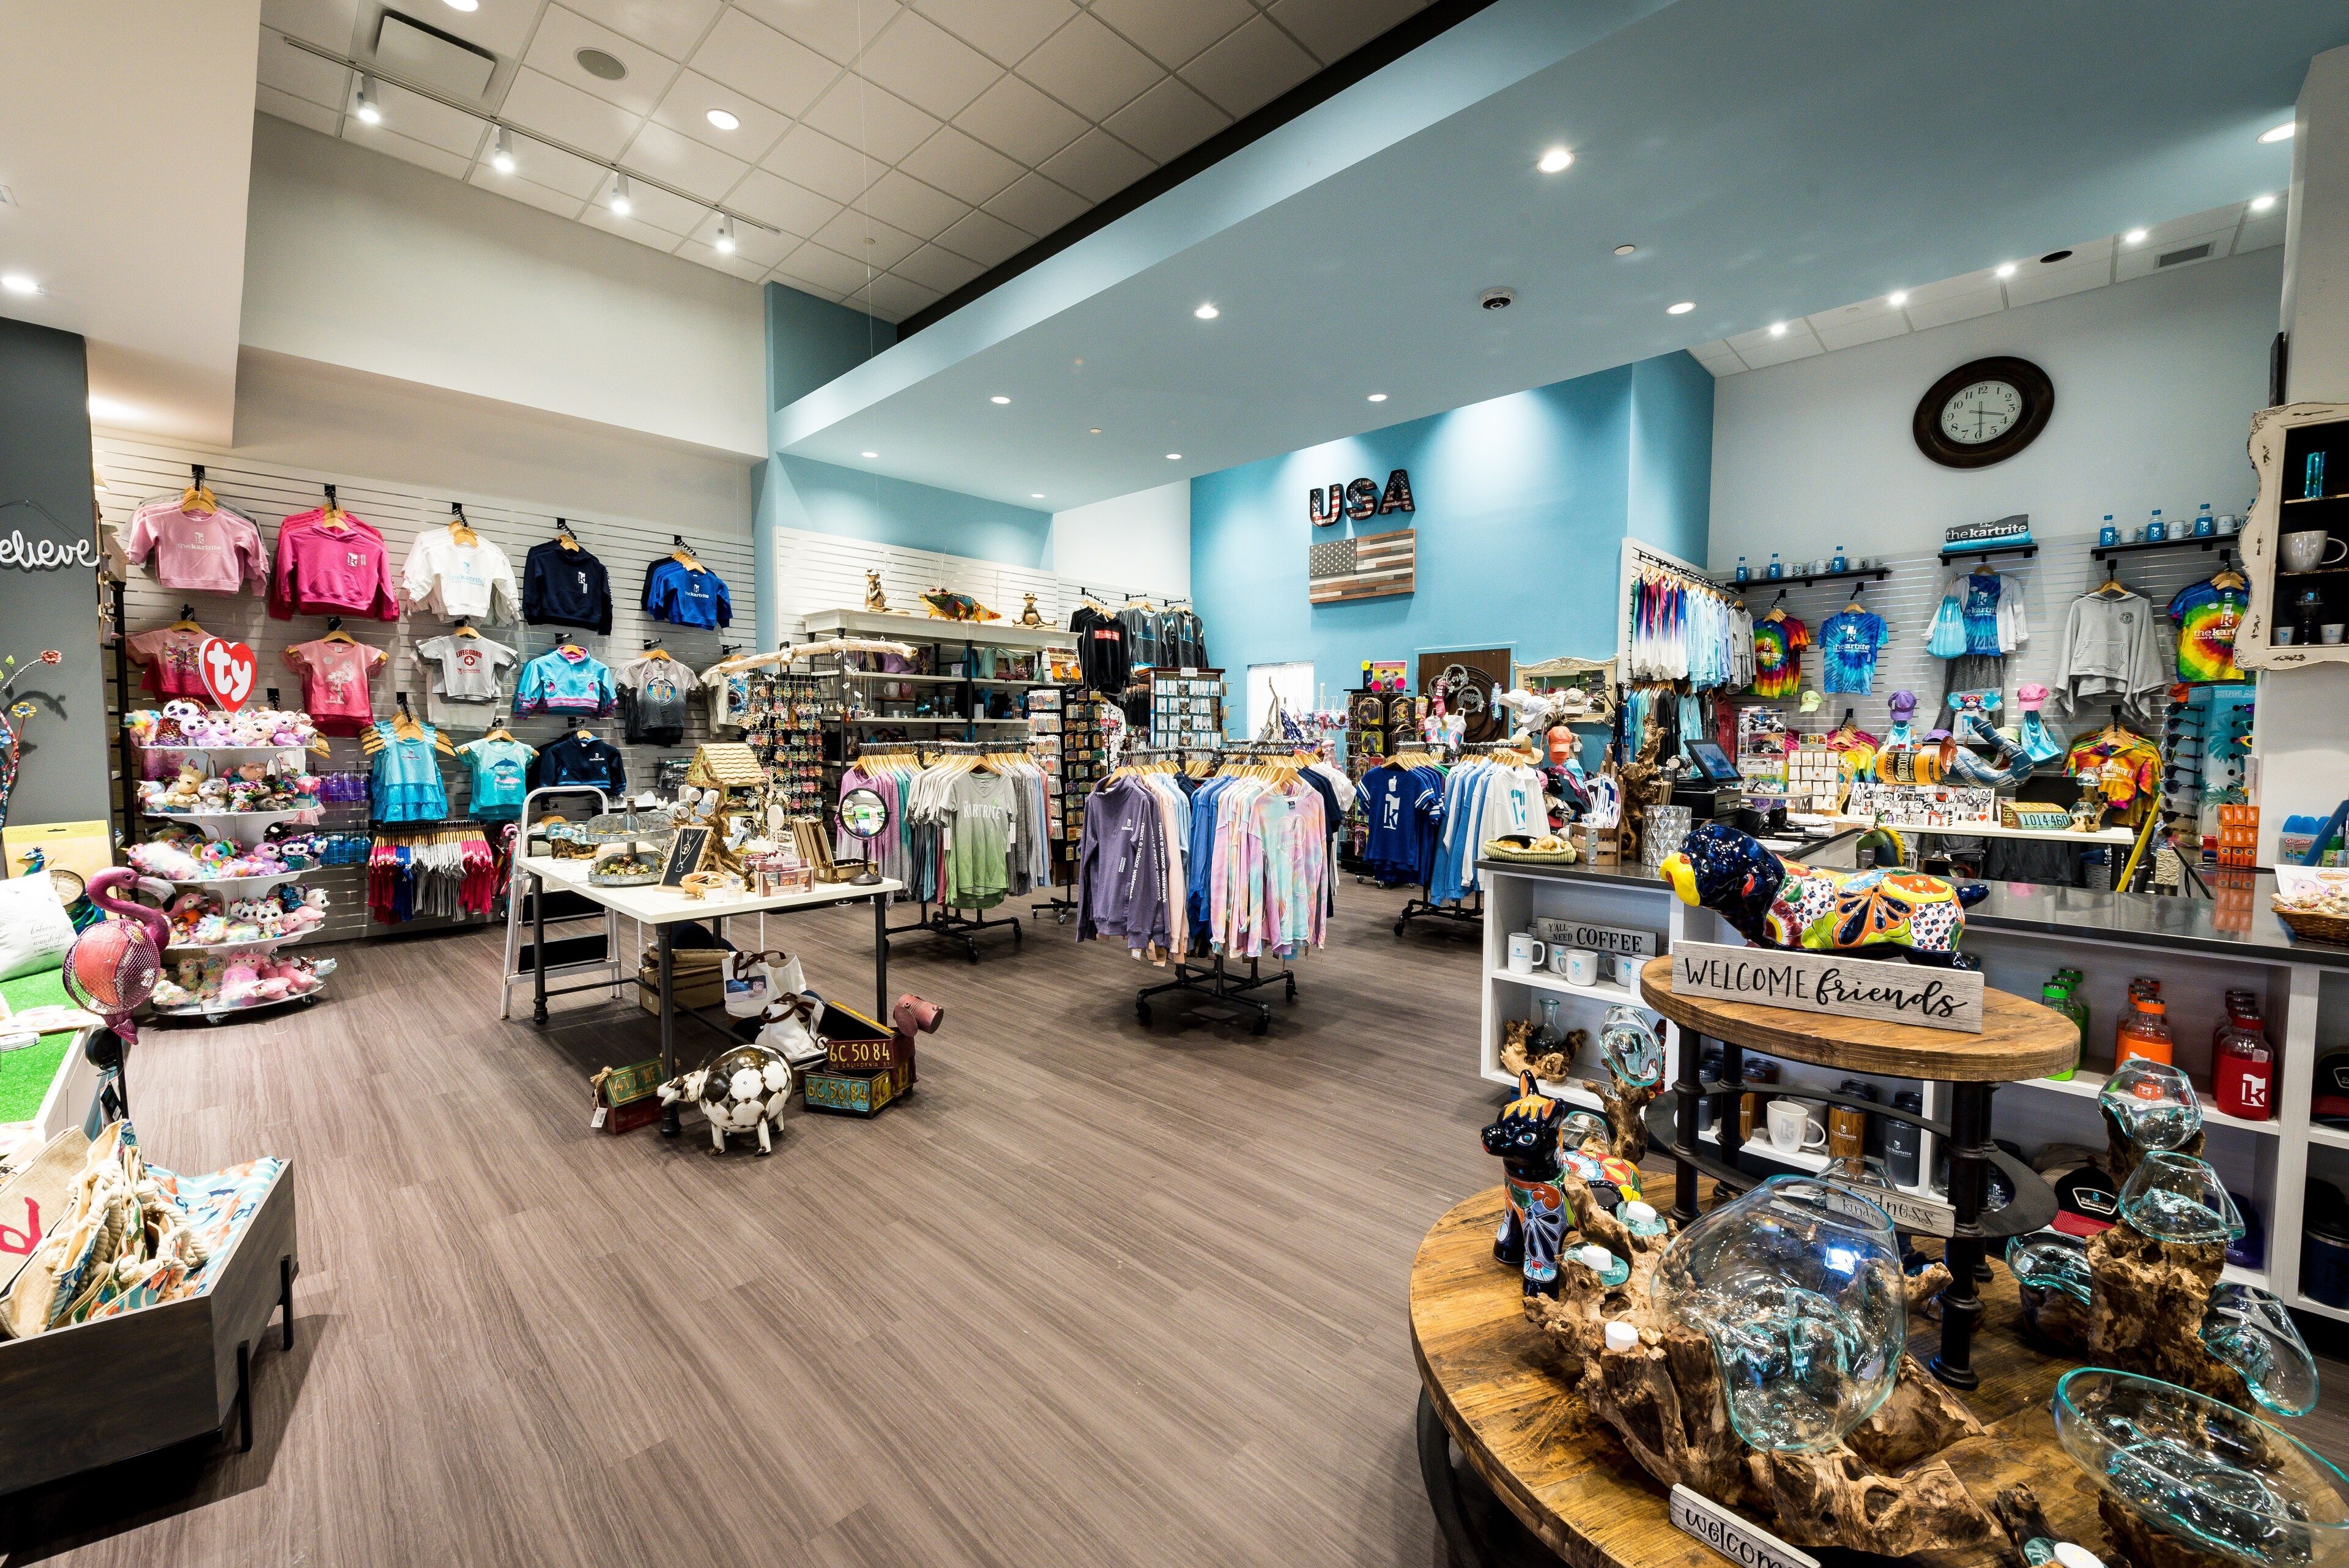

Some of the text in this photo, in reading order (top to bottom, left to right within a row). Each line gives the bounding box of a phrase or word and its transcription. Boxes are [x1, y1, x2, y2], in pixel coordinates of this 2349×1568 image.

[1978, 386, 1988, 395] 12
[1953, 401, 1963, 409] 10
[2008, 404, 2016, 413] 3
[1946, 413, 1954, 422] 9
[1950, 423, 1958, 432] 8
[1989, 426, 1997, 434] 5
[1962, 430, 1969, 439] 7
[1974, 431, 1982, 439] 6
[1310, 469, 1416, 528] USA
[0, 530, 100, 568] elieve
[2194, 628, 2236, 637] thekart
[456, 649, 482, 658] LIFEGUARD
[207, 642, 252, 702] ty
[1445, 671, 1466, 684] Love
[2214, 689, 2257, 699] SUNGLAS
[2102, 765, 2128, 776] KRTRITE
[1548, 923, 1568, 932] Y'ALL
[1553, 933, 1573, 942] NEED
[1576, 927, 1642, 953] COFFEE
[1685, 957, 1968, 1017] WELCOME friends
[829, 1042, 890, 1063] 6C 50 84
[807, 1077, 867, 1103] 6C 50 84
[819, 1099, 855, 1108] CALIFORNIA
[1842, 1198, 1882, 1222] kindn
[1848, 1186, 1934, 1228] ndness
[1686, 1508, 1792, 1568] welcom
